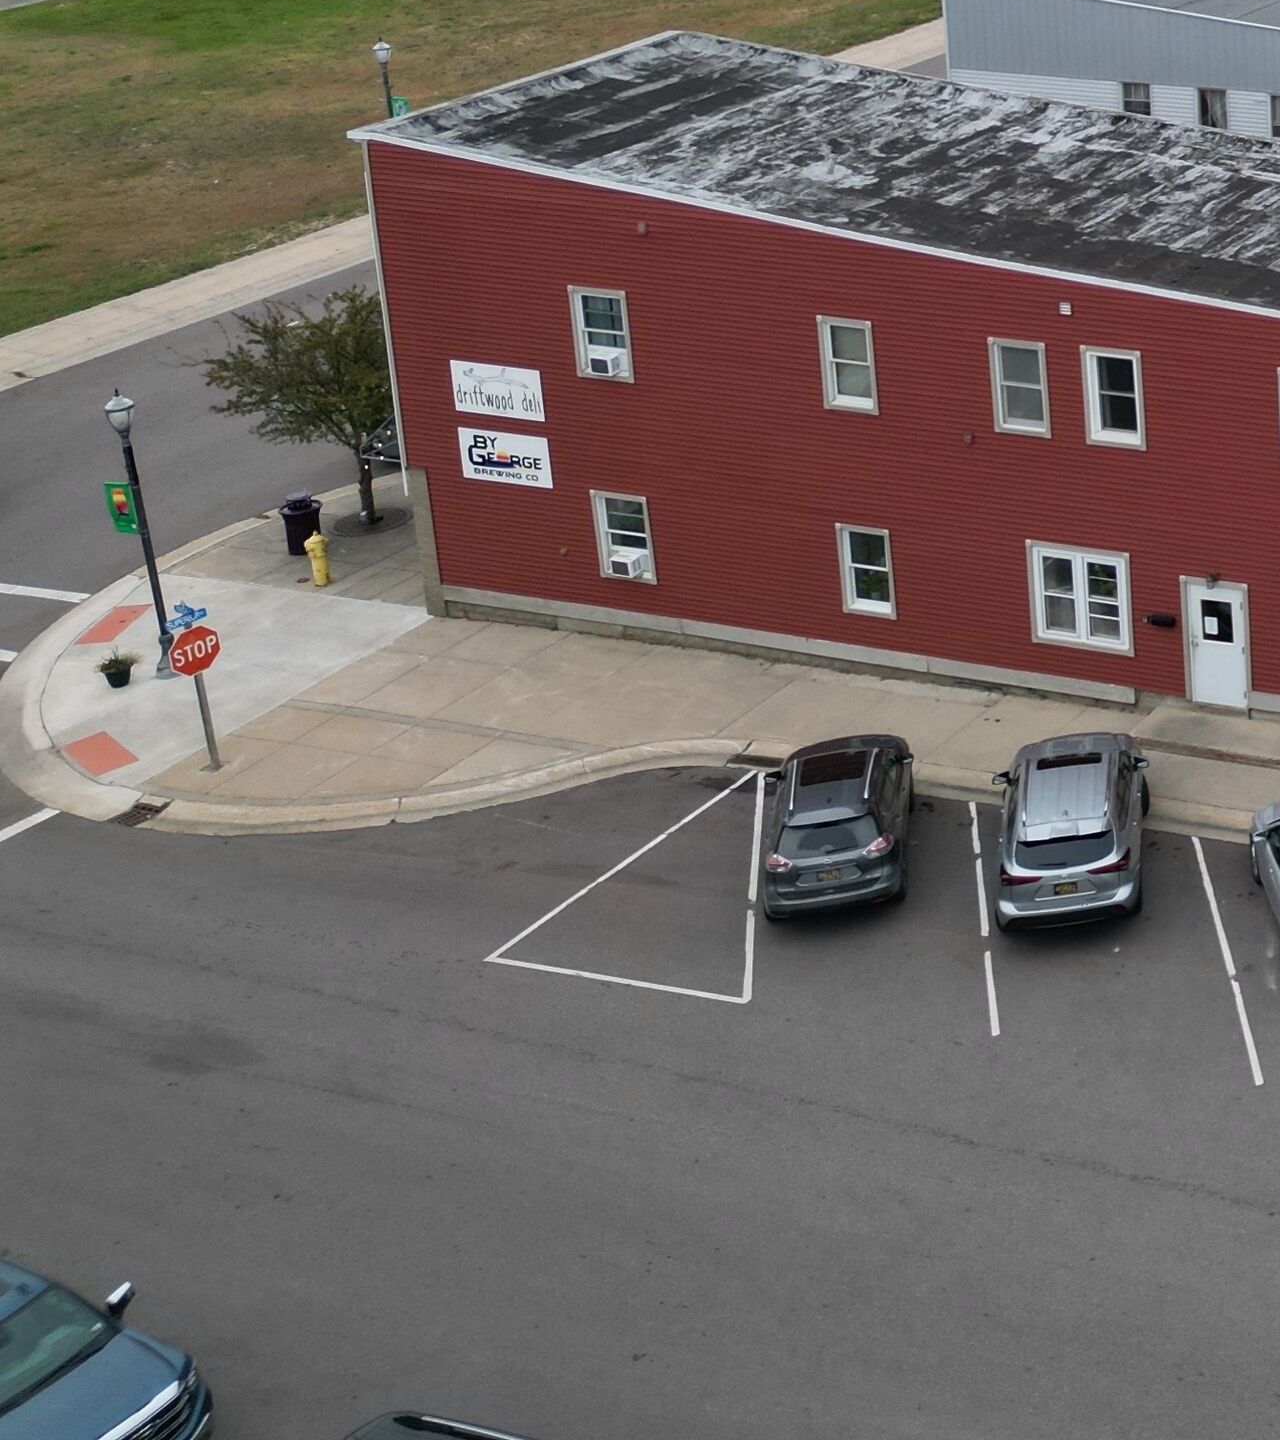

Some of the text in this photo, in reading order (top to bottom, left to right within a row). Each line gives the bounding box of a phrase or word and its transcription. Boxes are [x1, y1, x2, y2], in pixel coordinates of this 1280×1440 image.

[456, 383, 543, 413] driftwood deli
[473, 434, 498, 450] BY
[473, 467, 539, 482] BREWING CO
[173, 635, 217, 667] STOP
